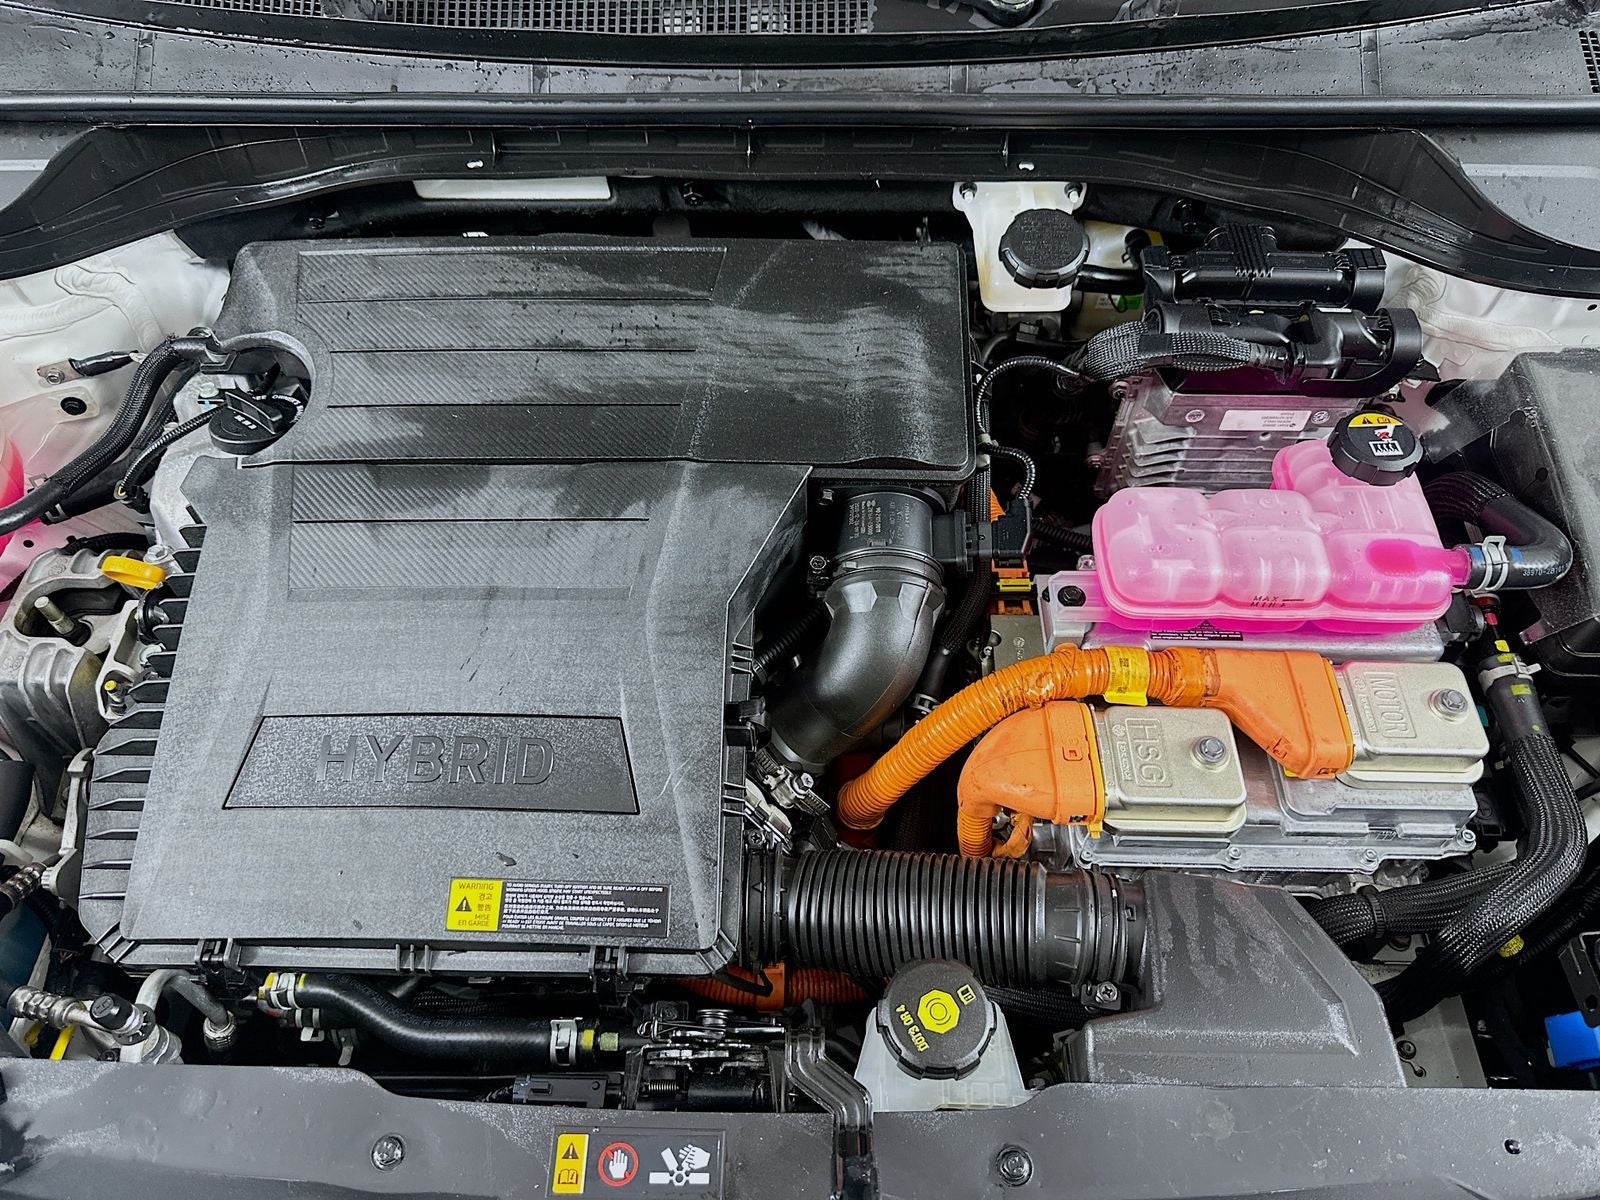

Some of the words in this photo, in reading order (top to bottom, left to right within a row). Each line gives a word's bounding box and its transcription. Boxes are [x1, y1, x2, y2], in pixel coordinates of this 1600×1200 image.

[1367, 675, 1410, 733] MOTOR
[316, 734, 555, 785] HYBRID
[1129, 723, 1167, 783] HSG
[458, 882, 494, 890] WARNING
[895, 1004, 906, 1013] 4
[899, 1010, 914, 1026] OR
[908, 1025, 929, 1052] DOT3
